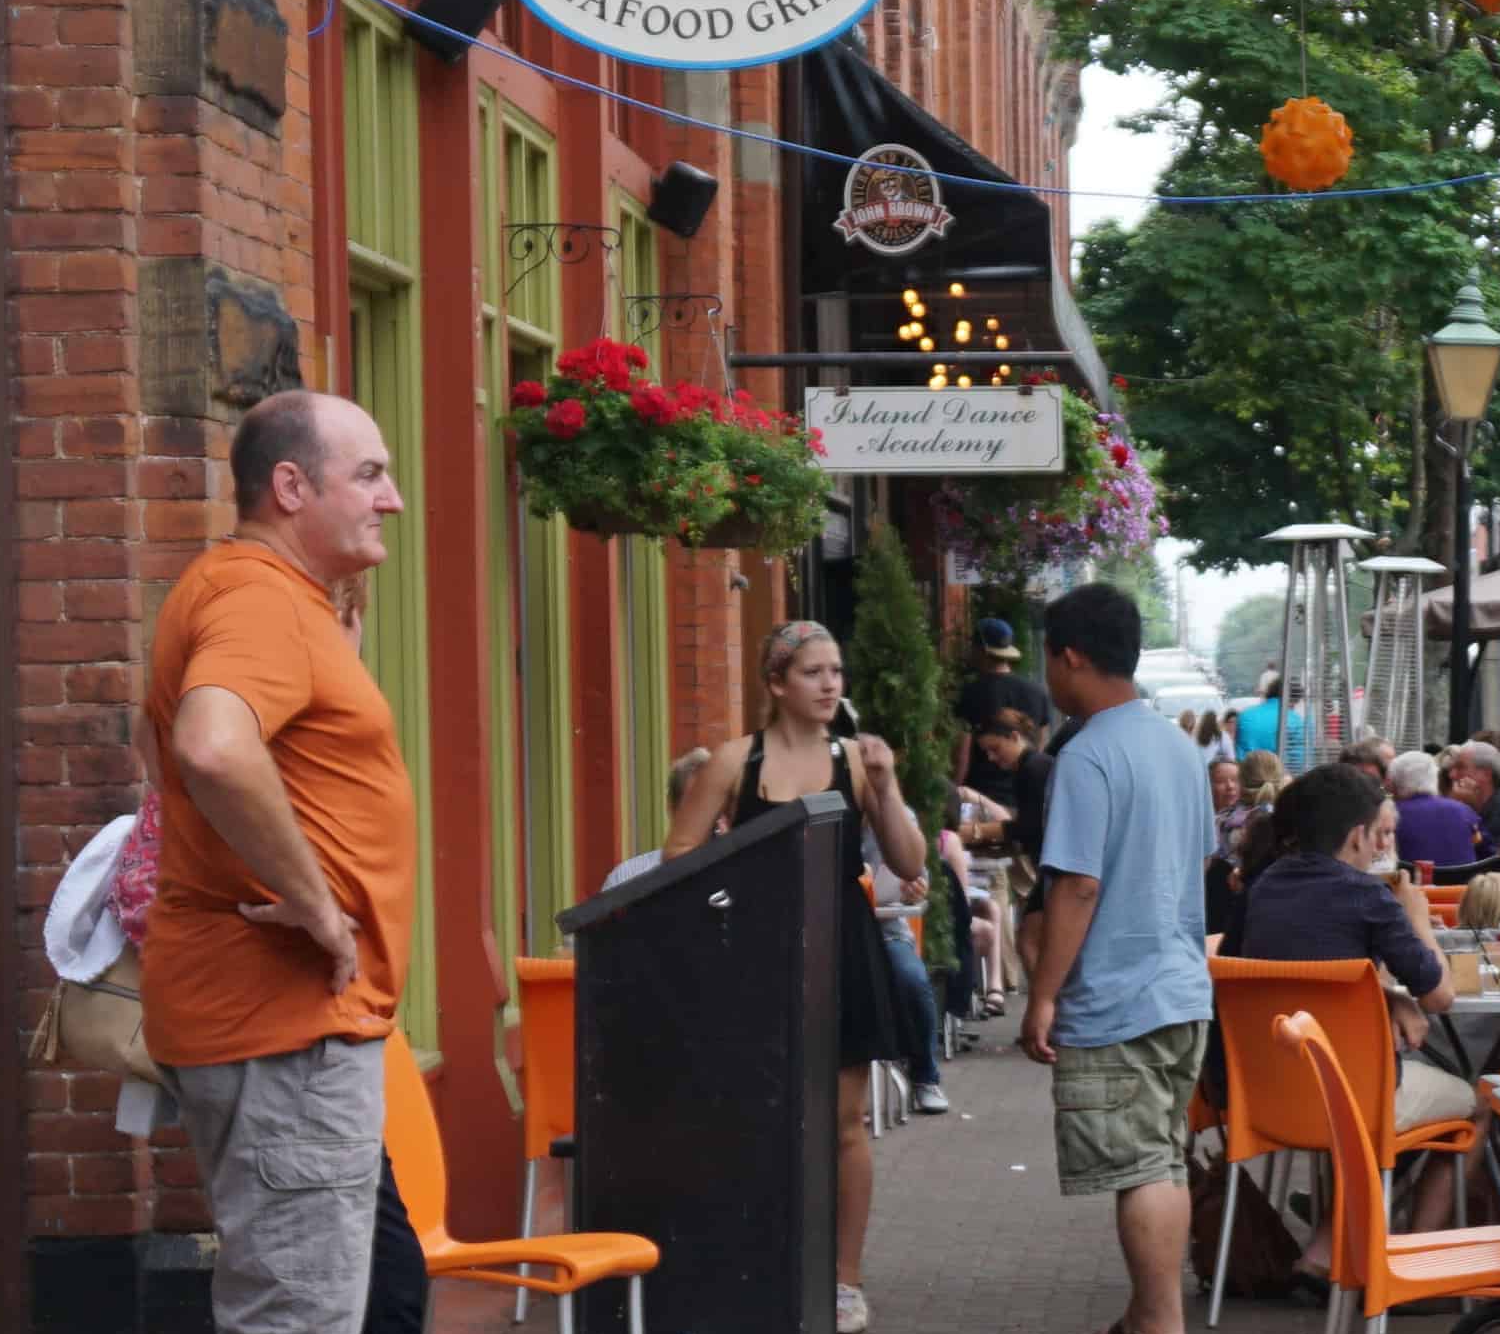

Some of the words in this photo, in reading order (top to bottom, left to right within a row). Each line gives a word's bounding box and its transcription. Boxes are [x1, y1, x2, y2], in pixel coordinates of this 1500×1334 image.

[887, 201, 934, 221] BROWN
[824, 399, 936, 426] Island
[942, 397, 1038, 424] Dance
[856, 427, 1006, 463] Academy
